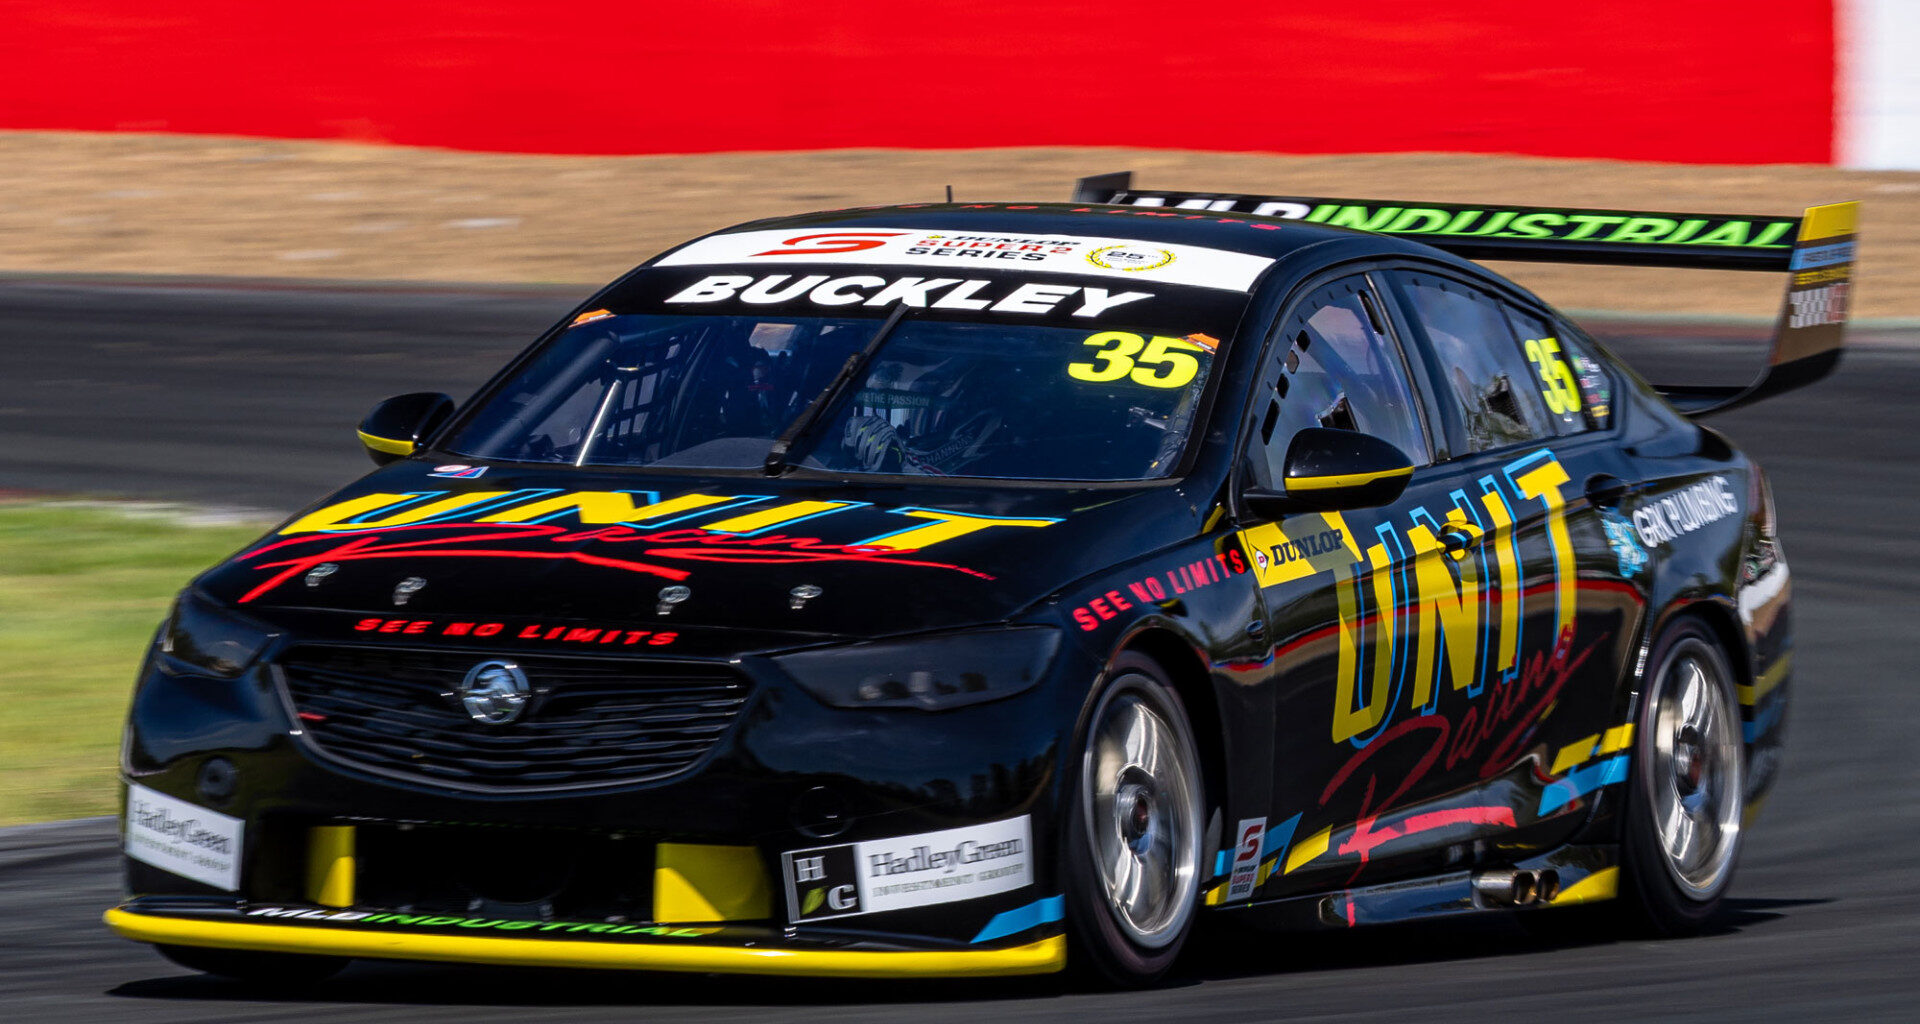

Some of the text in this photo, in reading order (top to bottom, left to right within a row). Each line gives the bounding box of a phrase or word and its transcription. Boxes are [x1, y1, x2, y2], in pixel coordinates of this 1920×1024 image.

[1305, 204, 1794, 248] INDUSTRIAL
[905, 247, 1047, 262] SERIES
[664, 274, 1156, 319] BUCKLEY
[1067, 331, 1204, 389] 35
[1524, 337, 1582, 414] 35
[279, 487, 1064, 551] UNIT
[1269, 528, 1344, 567] DUNLOP
[1072, 549, 1246, 632] SEE NO LIMITS
[1331, 449, 1571, 748] UNIT
[354, 618, 679, 645] SEE NO LIMITS
[793, 855, 828, 883] H
[868, 837, 1024, 878] HadleyGreen
[827, 883, 858, 911] G
